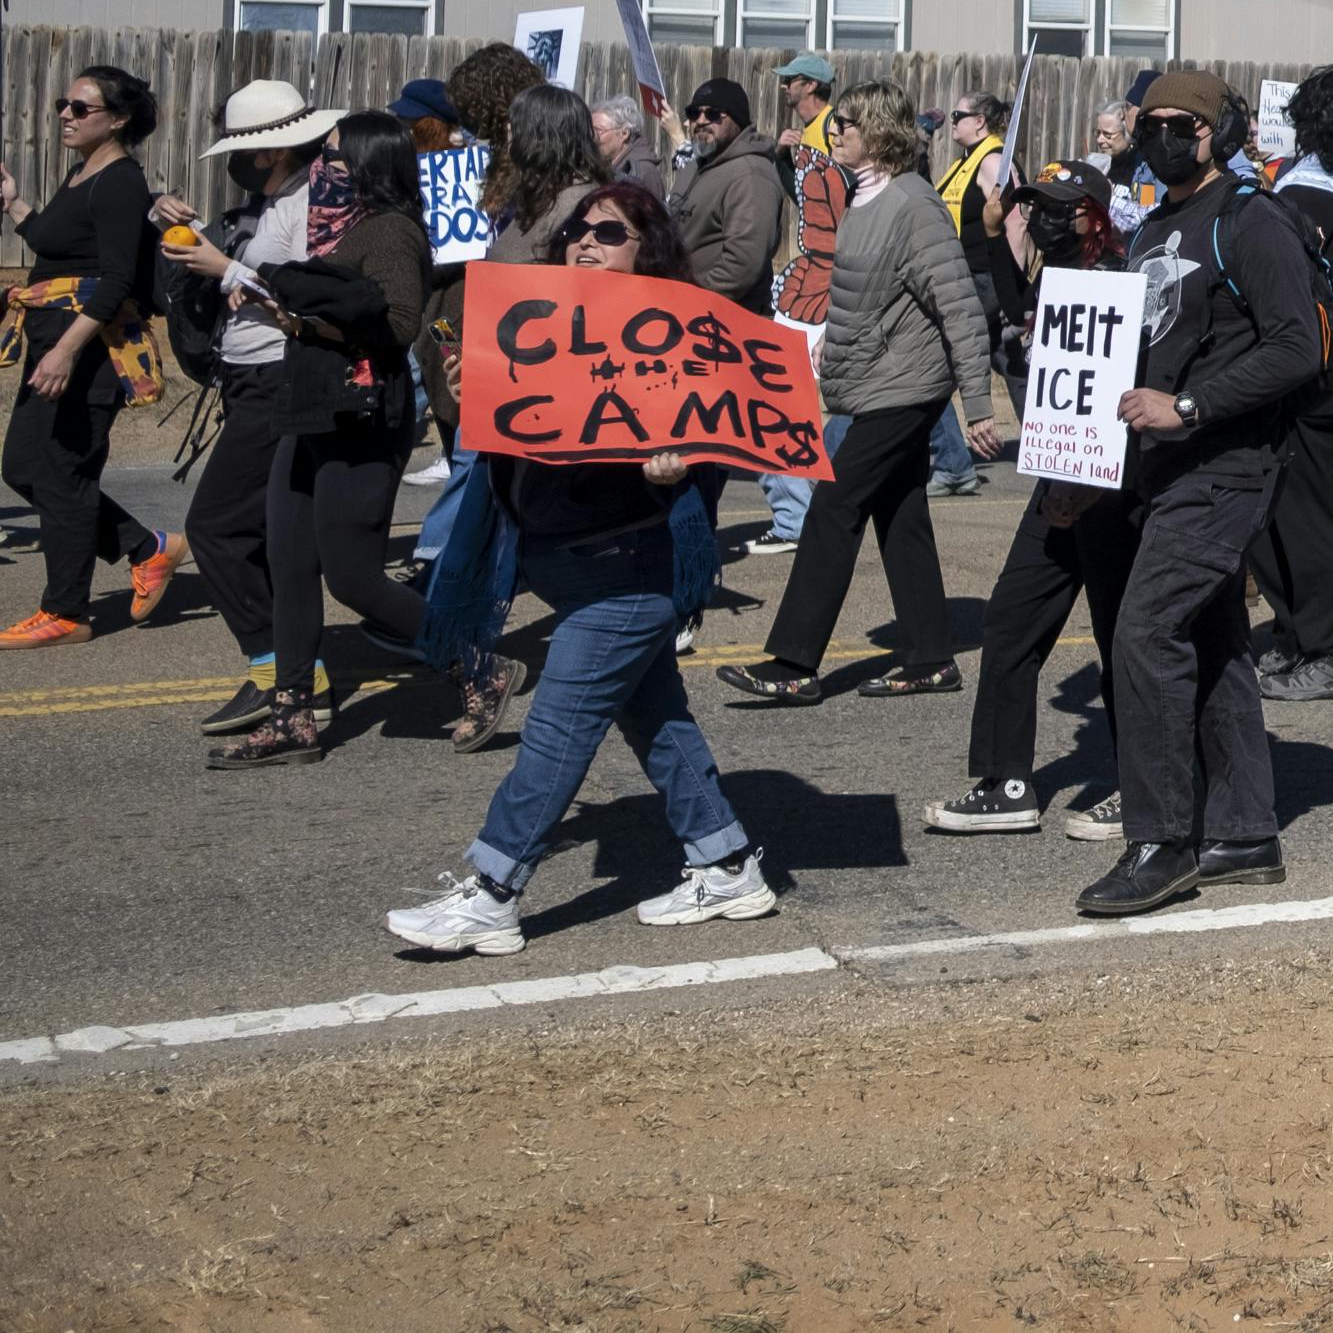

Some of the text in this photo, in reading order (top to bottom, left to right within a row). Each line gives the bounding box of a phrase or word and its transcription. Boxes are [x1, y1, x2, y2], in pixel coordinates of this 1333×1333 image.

[1035, 367, 1096, 416] ICE
[1024, 421, 1044, 435] NO
[1083, 443, 1104, 457] on
[1024, 452, 1120, 483] STOLEN land
